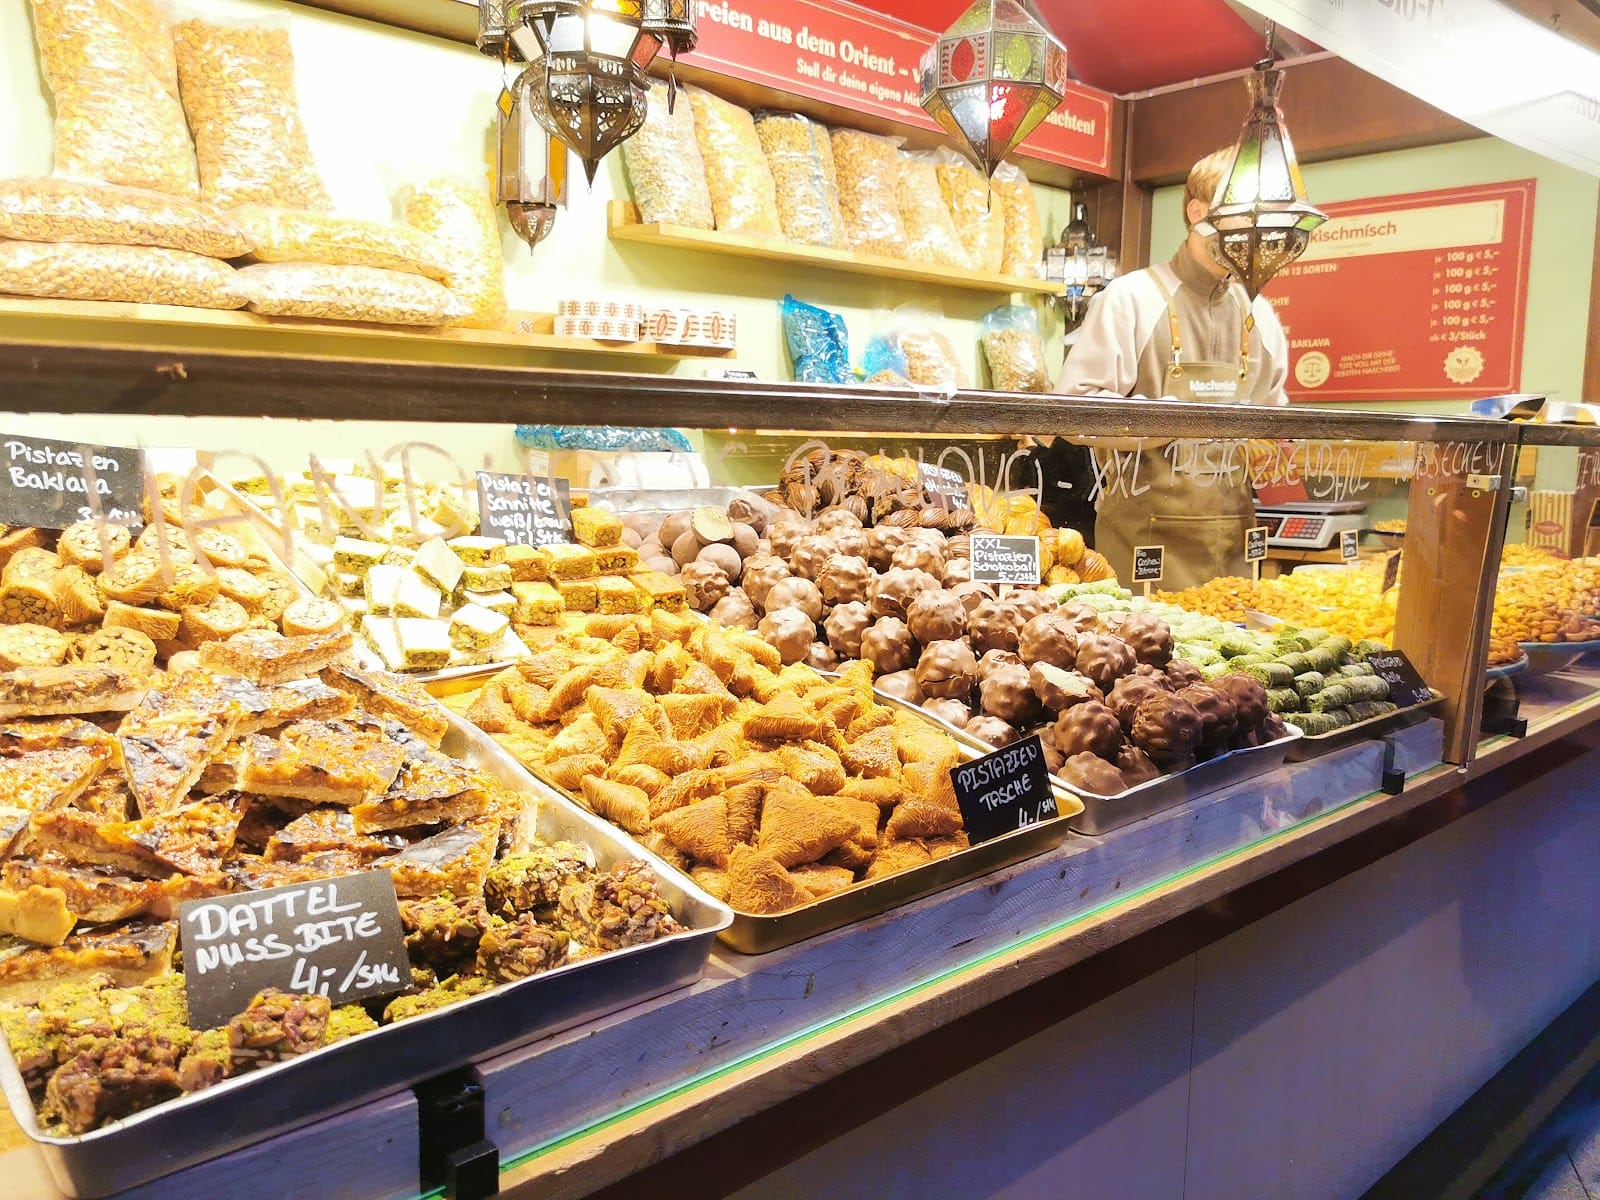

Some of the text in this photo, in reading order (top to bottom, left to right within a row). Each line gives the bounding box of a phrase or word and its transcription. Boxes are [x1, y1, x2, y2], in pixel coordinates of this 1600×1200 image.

[698, 0, 753, 33] reien
[757, 19, 792, 45] aus
[796, 26, 836, 58] dem
[839, 40, 896, 77] Orient
[797, 58, 821, 79] Stell
[822, 66, 838, 82] dir
[839, 73, 867, 93] deine
[869, 80, 902, 102] eigene
[1447, 251, 1465, 262] 100
[1466, 253, 1474, 263] g
[1302, 263, 1338, 275] SORTEN
[1446, 268, 1464, 278] 100
[1465, 269, 1473, 279] g
[1445, 283, 1463, 294] 100
[1464, 285, 1472, 295] g
[1444, 299, 1461, 310] 100
[1463, 301, 1471, 311] g
[1443, 315, 1460, 326] 100
[1462, 317, 1469, 327] g
[1291, 338, 1330, 348] BAKLAVA
[1088, 440, 1151, 502] XXL
[975, 538, 1011, 550] XXL
[975, 550, 1033, 562] Pistazien
[974, 562, 1036, 572] Schokoball
[957, 744, 1038, 793] PISTAZIEN
[979, 773, 1033, 811] TASCHE
[187, 883, 362, 941] DATTEL
